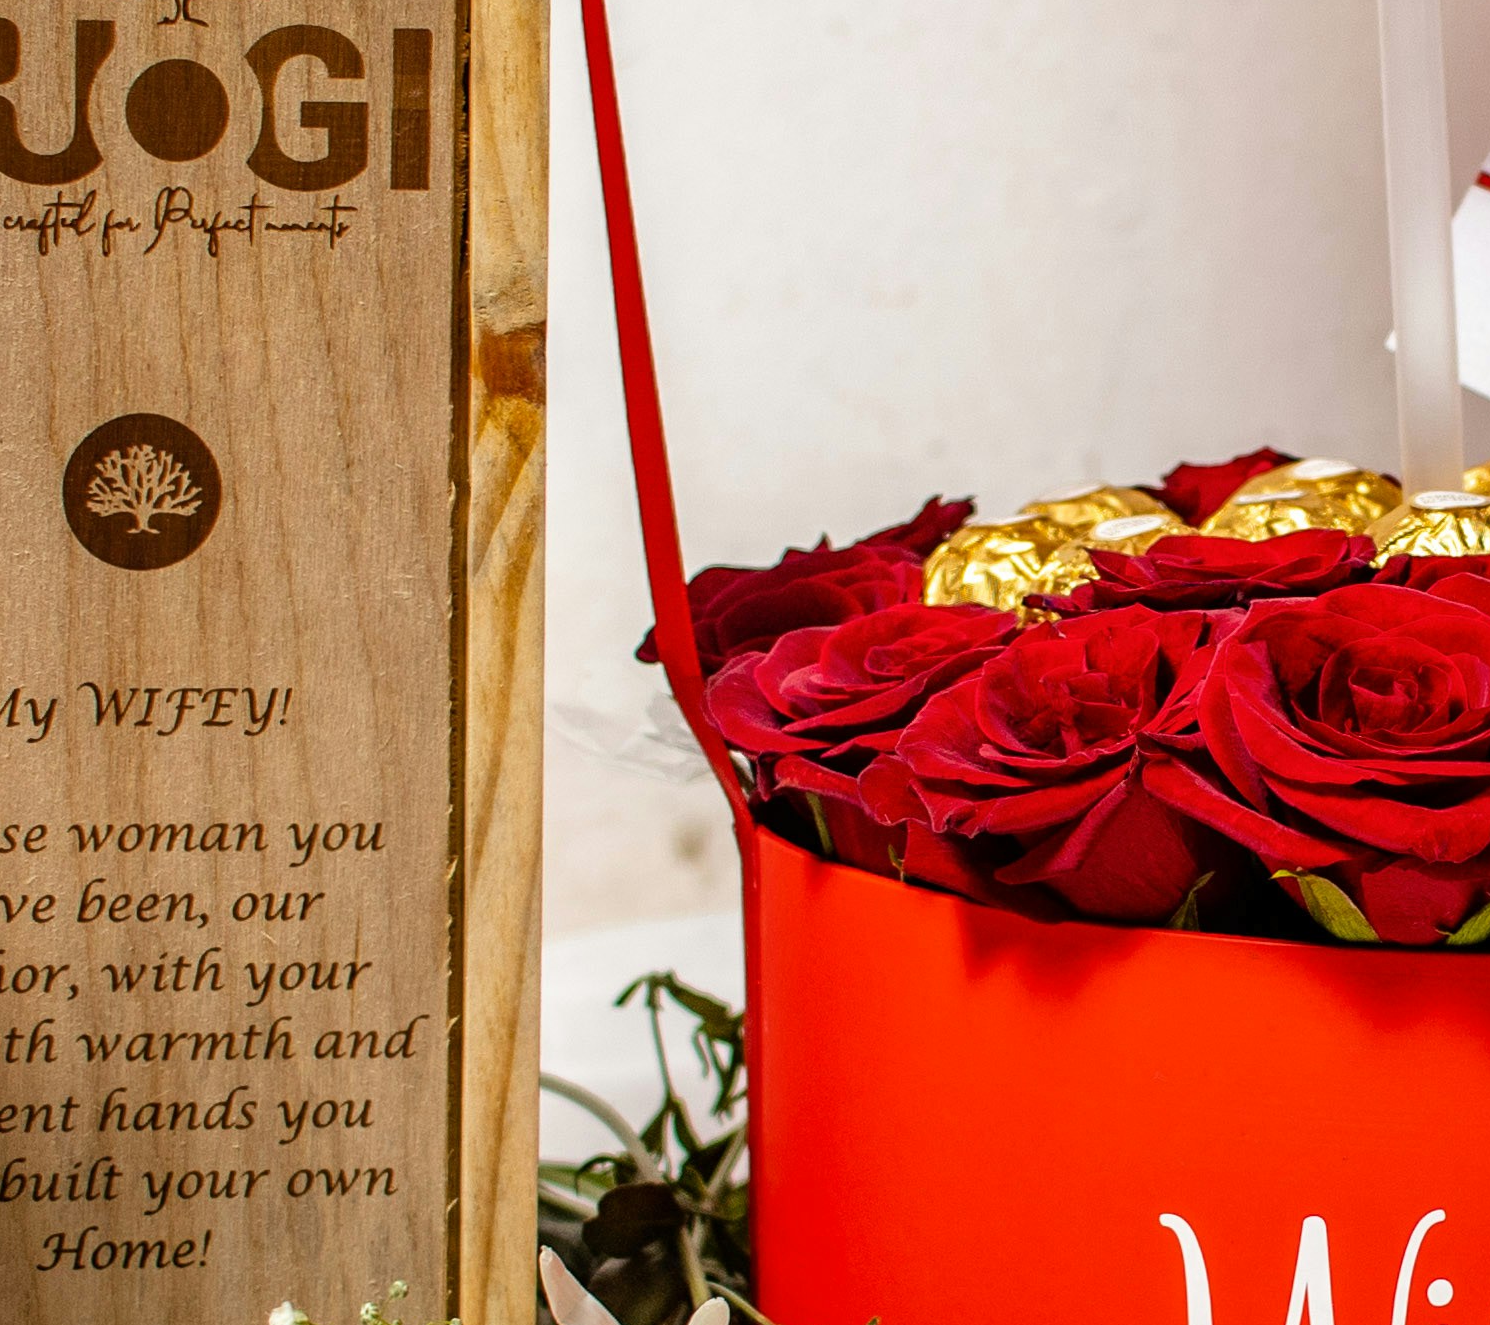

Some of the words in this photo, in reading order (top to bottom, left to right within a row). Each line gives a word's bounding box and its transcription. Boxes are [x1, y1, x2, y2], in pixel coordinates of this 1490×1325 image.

[3, 187, 98, 256] crafted
[102, 208, 142, 257] for
[143, 187, 277, 258] Perfect
[77, 681, 296, 739] WIFEY!
[67, 820, 269, 853] woman
[286, 816, 388, 867] you
[75, 878, 211, 929] been,
[231, 891, 325, 922] our
[100, 946, 224, 993] with
[242, 957, 372, 1007] your
[76, 1015, 293, 1062] warmth
[313, 1014, 430, 1061] and
[97, 1085, 256, 1132] hands
[276, 1094, 374, 1146] you
[141, 1165, 270, 1216] your
[286, 1163, 398, 1198] own
[36, 1225, 214, 1272] Home!
